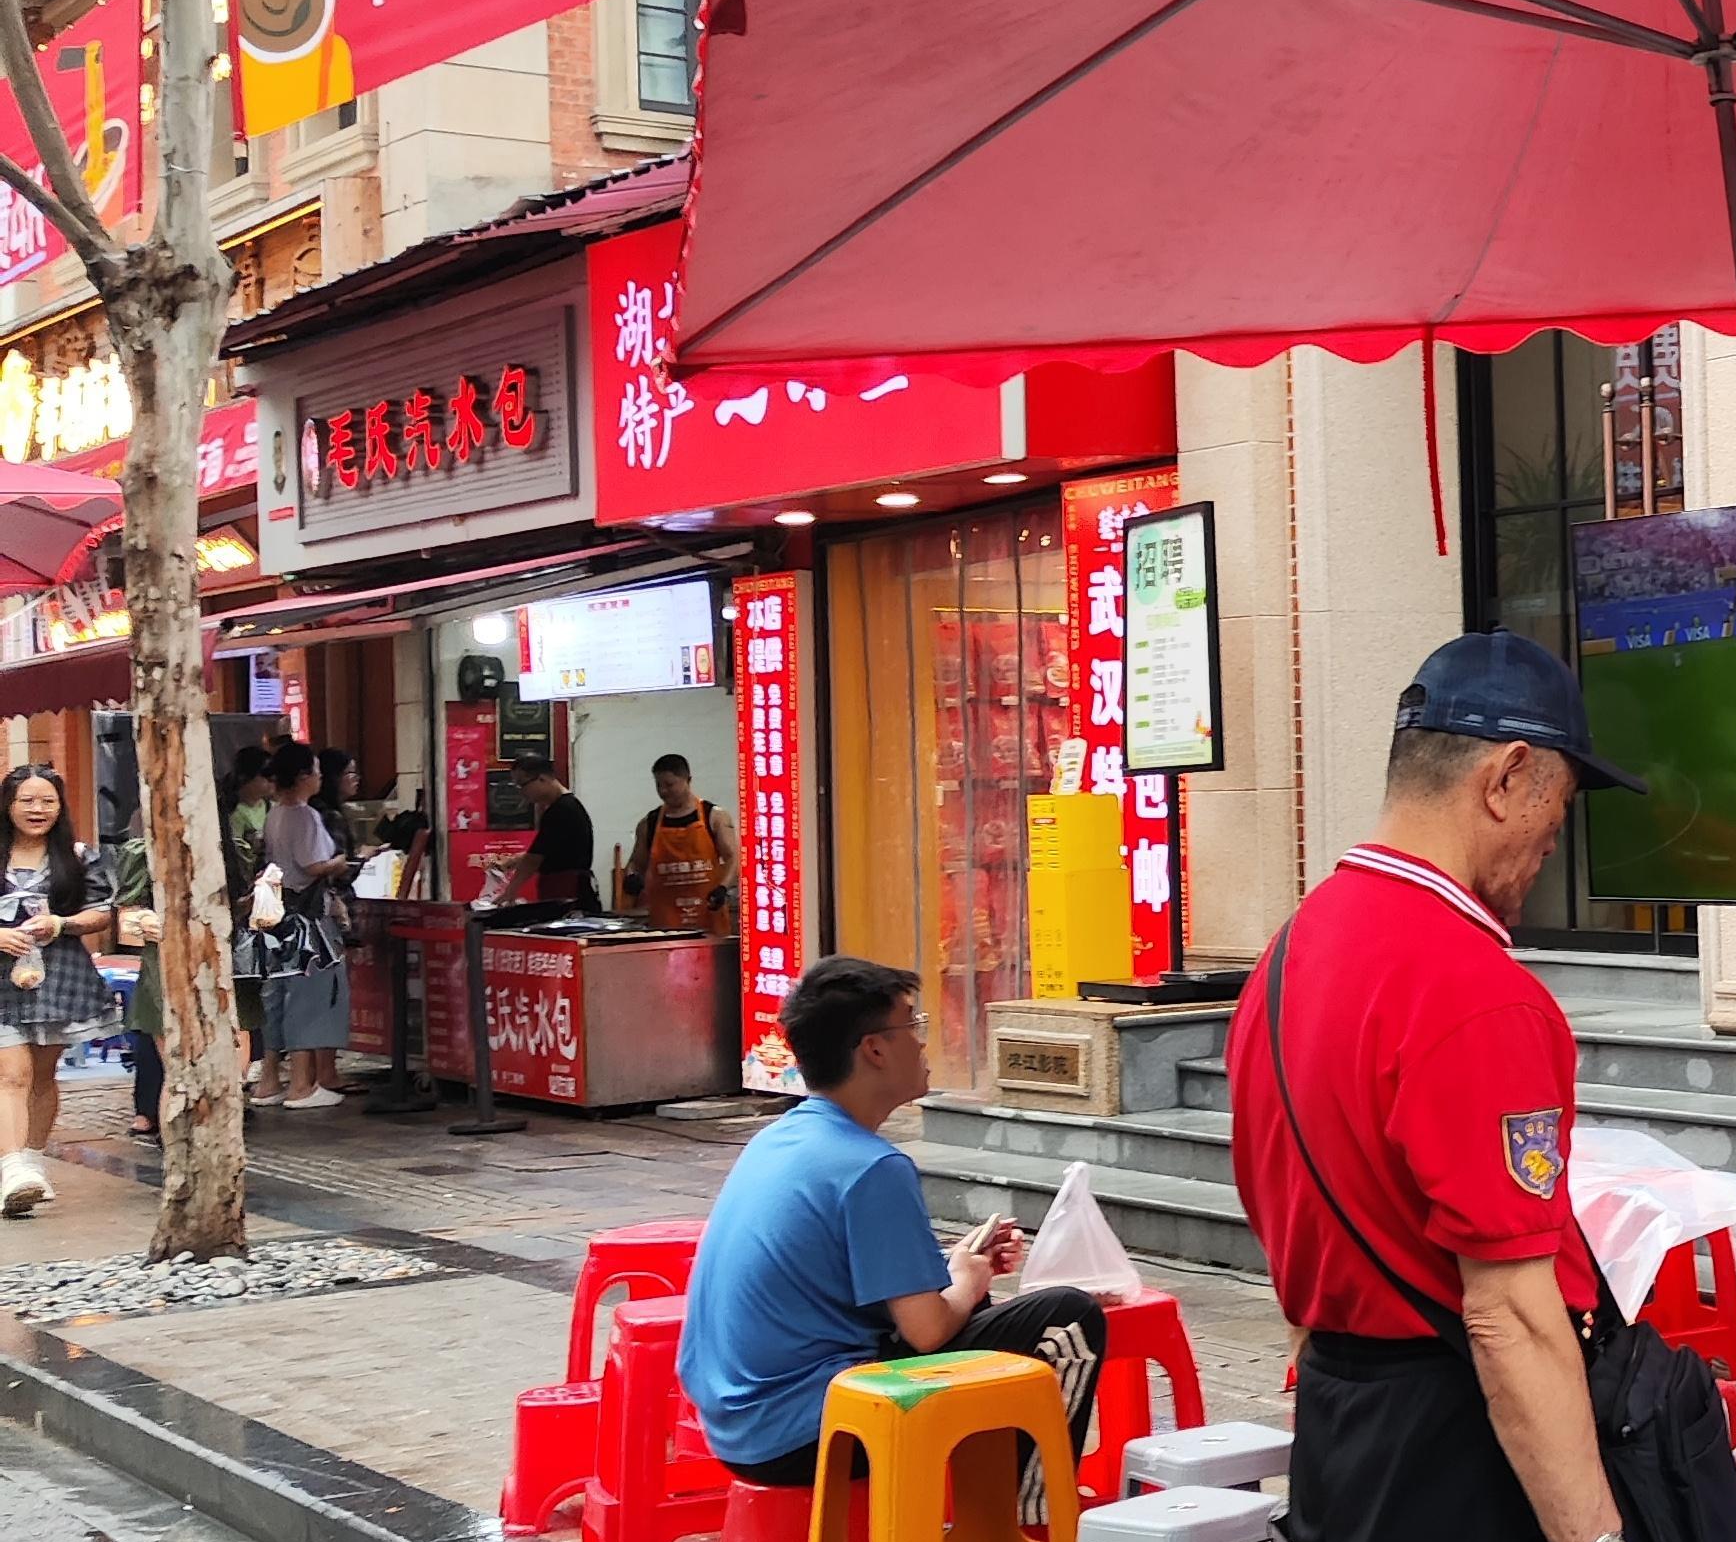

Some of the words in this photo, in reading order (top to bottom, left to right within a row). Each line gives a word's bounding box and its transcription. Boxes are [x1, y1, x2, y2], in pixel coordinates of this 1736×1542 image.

[327, 363, 537, 490] 毛氏汽水包
[1625, 633, 1652, 649] VISA
[1684, 626, 1711, 642] VISA
